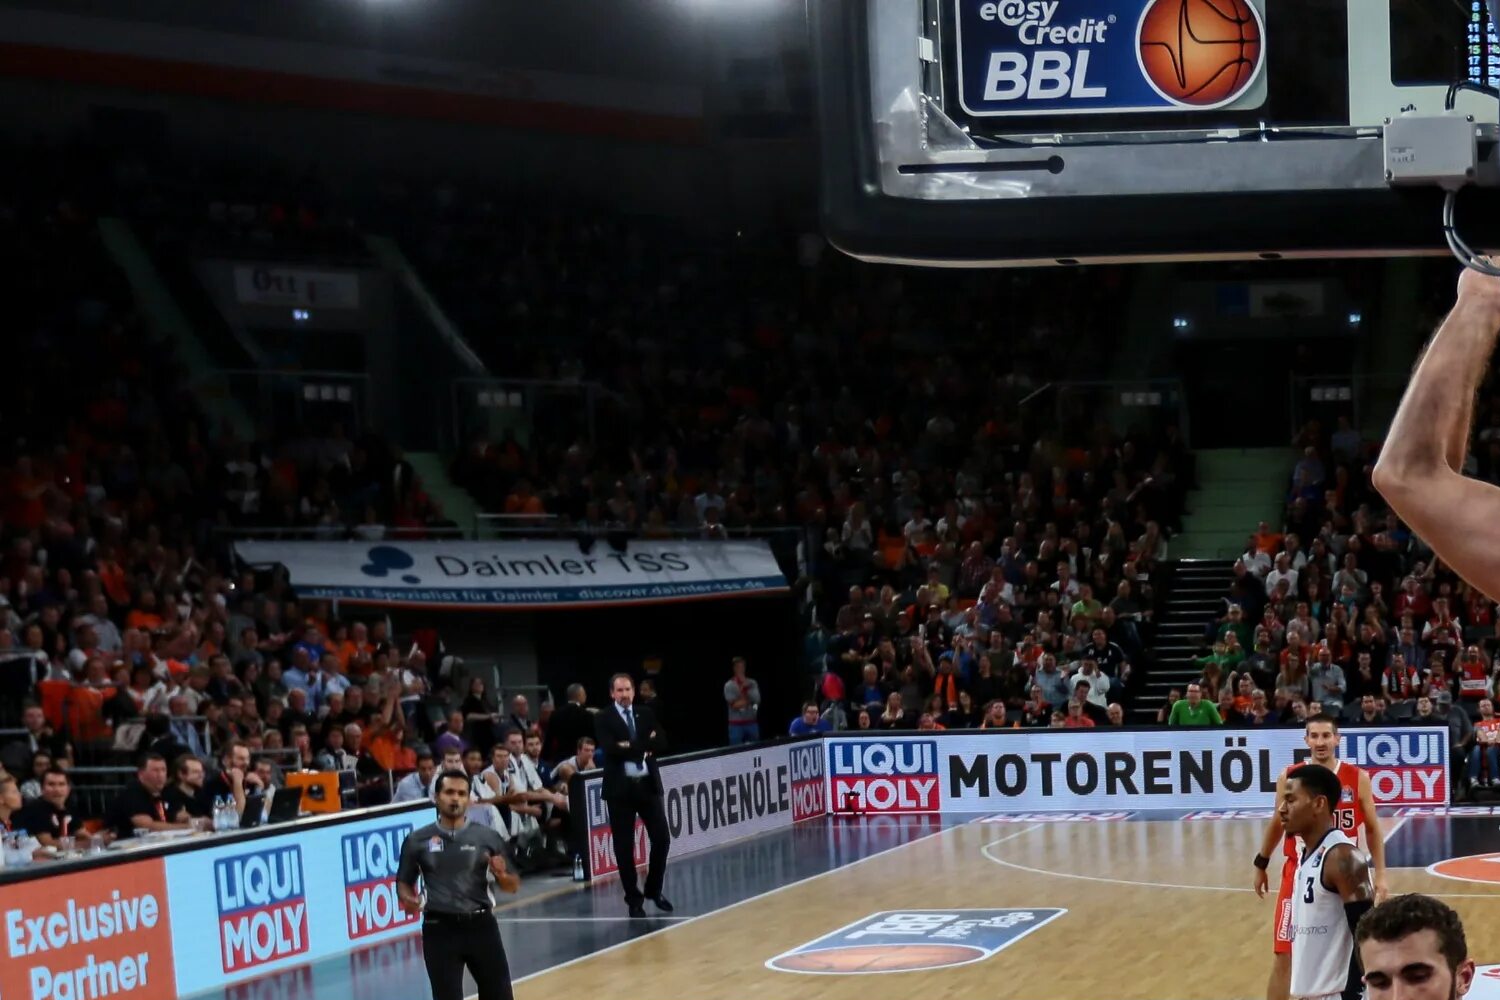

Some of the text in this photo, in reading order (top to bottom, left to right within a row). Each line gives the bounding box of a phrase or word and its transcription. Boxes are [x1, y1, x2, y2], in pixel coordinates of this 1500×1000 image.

[1468, 23, 1480, 32] 11
[1468, 34, 1480, 43] 14
[1468, 45, 1480, 54] 15
[1468, 56, 1480, 65] 17
[983, 50, 1108, 100] BBL
[435, 551, 690, 577] Daimler TSS
[371, 588, 458, 602] Spezialist
[492, 590, 559, 602] Daimler
[790, 743, 823, 783] LIQUI
[833, 743, 934, 779] LIQUI
[1342, 734, 1440, 767] LIQUI
[949, 736, 1312, 799] MOTORENÖL
[667, 752, 790, 840] OTORENÖLE
[836, 778, 938, 810] MOLY
[1369, 769, 1444, 800] OLY
[792, 781, 824, 822] MOLY
[217, 849, 301, 910] LIQUI
[1304, 876, 1315, 904] 3
[6, 889, 159, 959] Exclusive
[347, 878, 418, 937] MOL
[223, 903, 306, 969] MOLY
[845, 914, 959, 939] BBL
